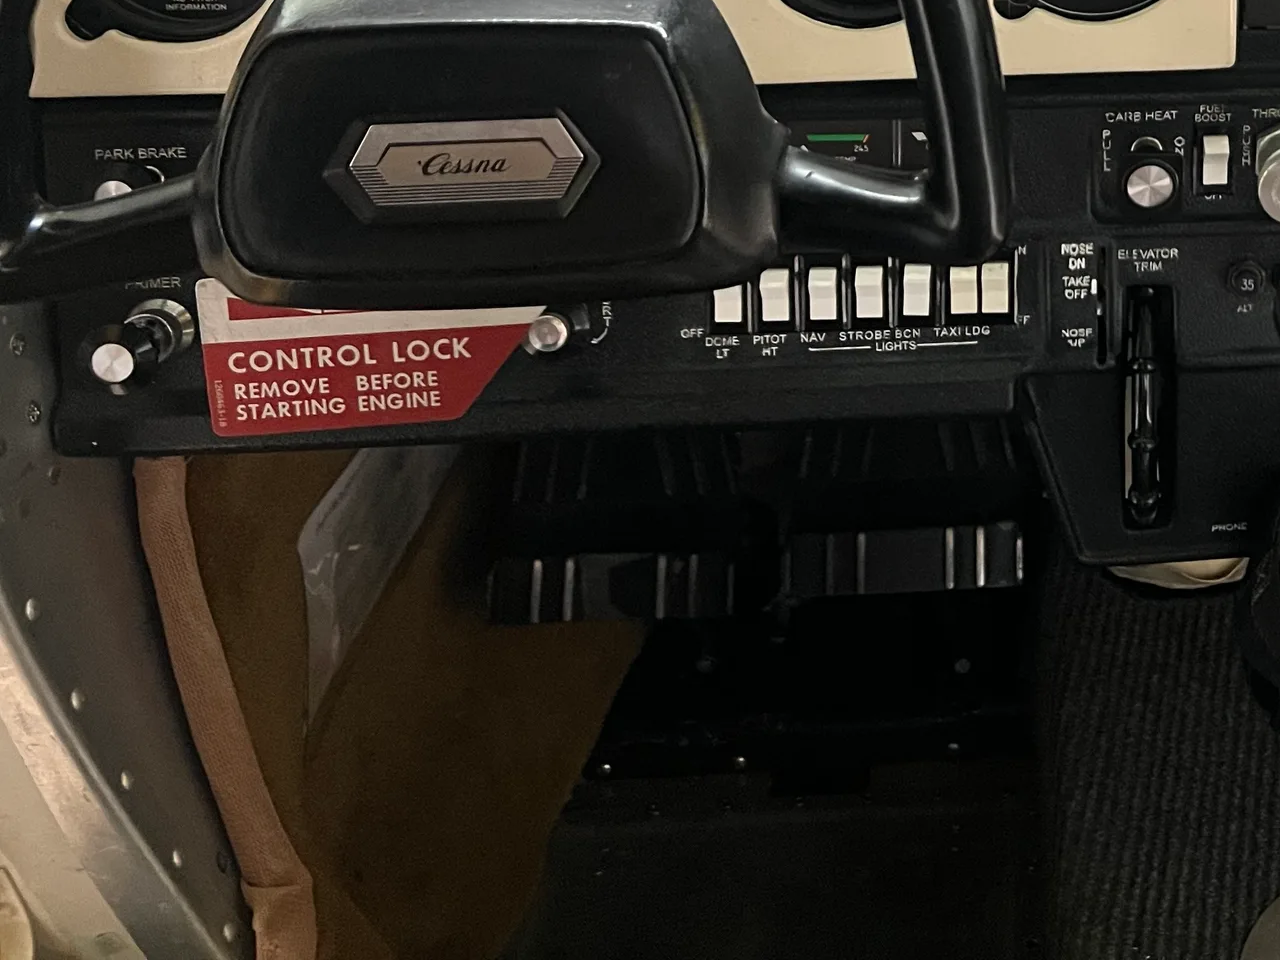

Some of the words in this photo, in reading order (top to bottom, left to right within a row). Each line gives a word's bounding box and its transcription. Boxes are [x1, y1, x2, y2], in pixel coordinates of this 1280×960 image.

[165, 3, 228, 11] INFORMATION
[1105, 112, 1141, 122] CARB
[1145, 110, 1178, 121] HEAT
[1195, 113, 1232, 122] BOOST
[1102, 129, 1111, 171] PULL
[1242, 125, 1251, 167] PUSH
[94, 148, 135, 160] PARK
[137, 147, 188, 159] BRAKE
[418, 152, 512, 176] Cessna
[1061, 243, 1094, 256] NOSE
[1117, 248, 1179, 260] ELEVATOR
[1134, 261, 1163, 272] TRIM
[1062, 275, 1090, 287] TAKE
[1240, 279, 1254, 291] 35
[1065, 288, 1088, 299] OFF
[680, 329, 704, 339] OFF
[753, 334, 787, 345] PITOT
[800, 332, 826, 342] NAV
[839, 330, 891, 341] STROBE
[895, 329, 920, 340] BCN
[934, 326, 961, 337] TAXI
[964, 325, 990, 336] LDG
[705, 336, 740, 347] DOME
[875, 341, 917, 352] LIGHTS
[1067, 338, 1086, 347] UP
[227, 343, 377, 374] CONTROL
[392, 336, 472, 362] LOCK
[762, 346, 778, 357] HT
[234, 377, 330, 400] REMOVE
[356, 370, 439, 392] BEFORE
[236, 397, 346, 421] STARTING
[358, 390, 441, 412] ENGINE
